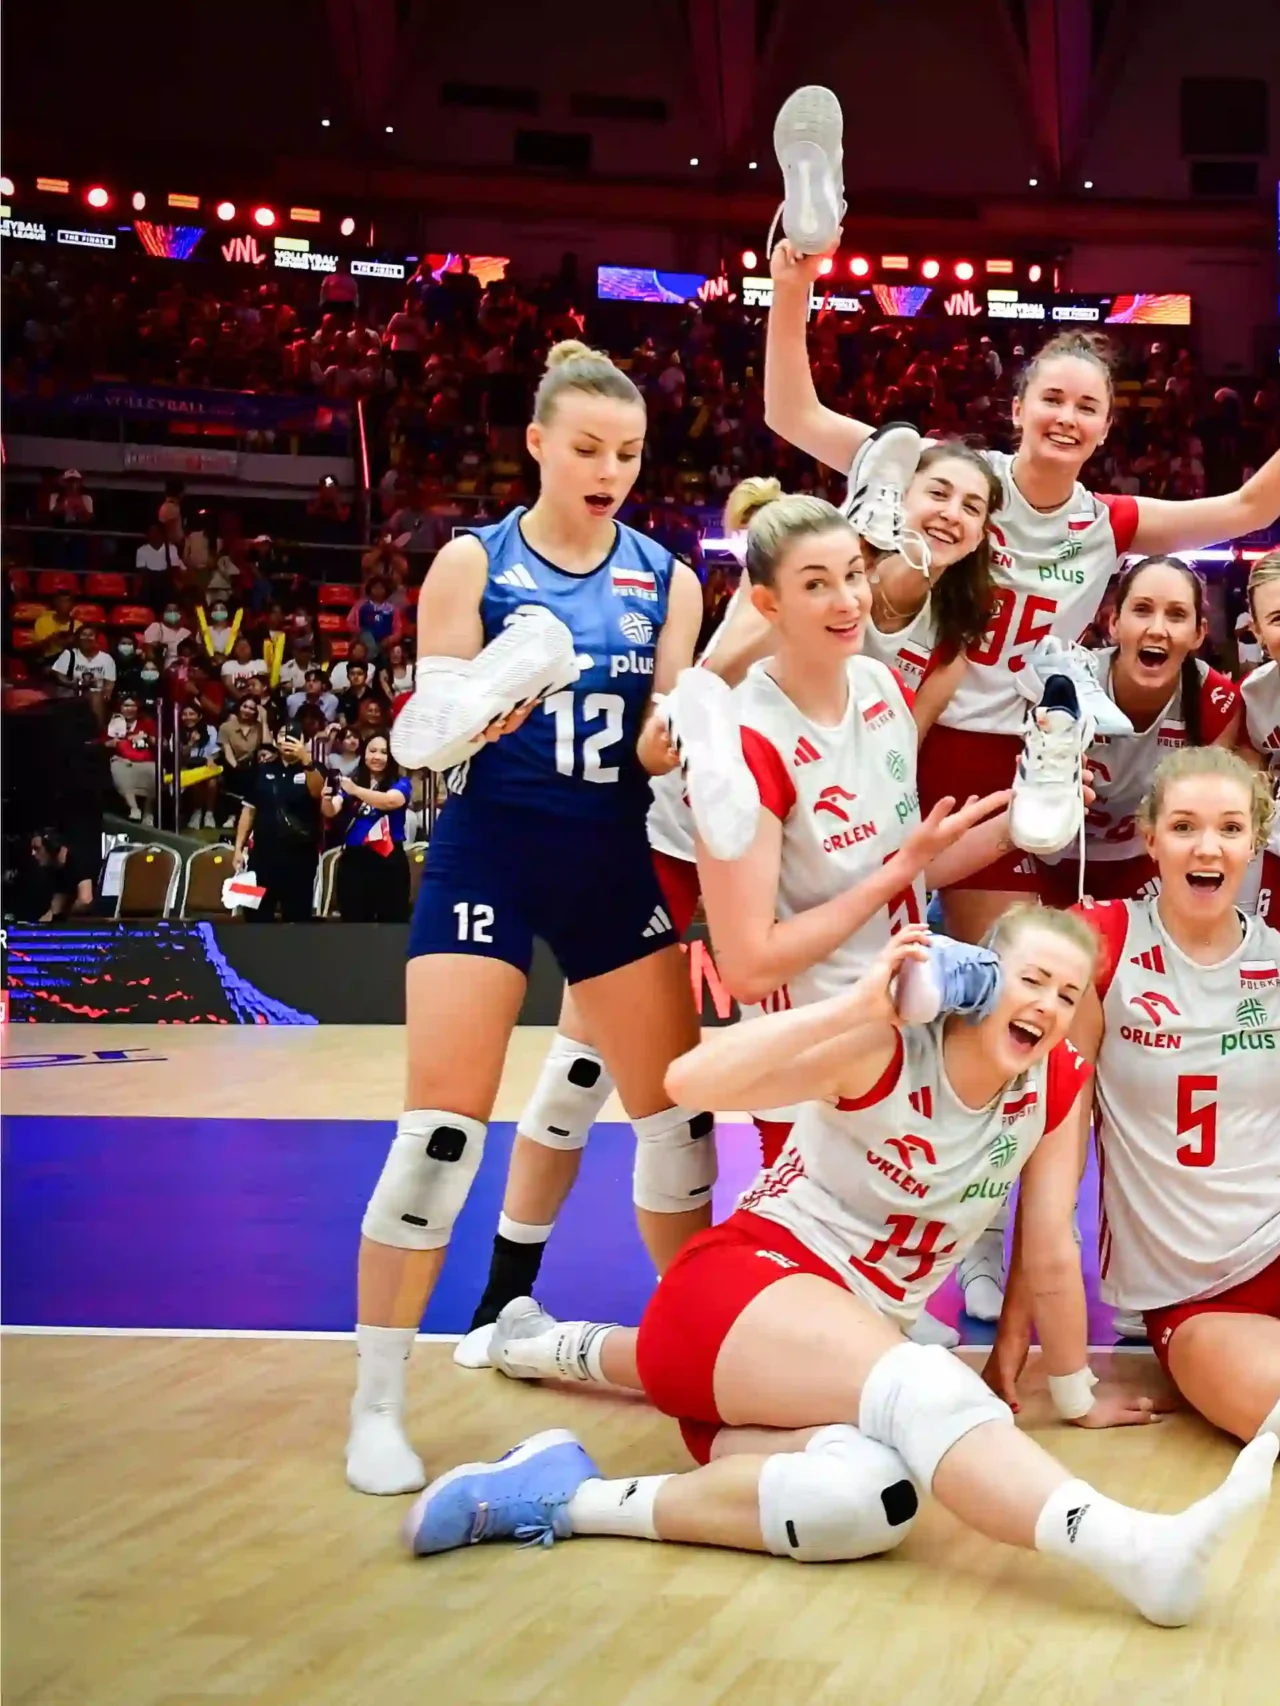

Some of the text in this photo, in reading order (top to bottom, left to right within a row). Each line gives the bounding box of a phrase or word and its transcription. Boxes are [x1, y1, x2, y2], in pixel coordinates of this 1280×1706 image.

[1038, 564, 1085, 584] plus
[544, 691, 626, 783] 12
[823, 820, 878, 853] ORLEN
[453, 902, 495, 944] 12
[1120, 1025, 1182, 1050] ORLEN
[1221, 1029, 1277, 1056] plus
[1176, 1074, 1218, 1168] 5
[866, 1150, 931, 1199] ORLEN
